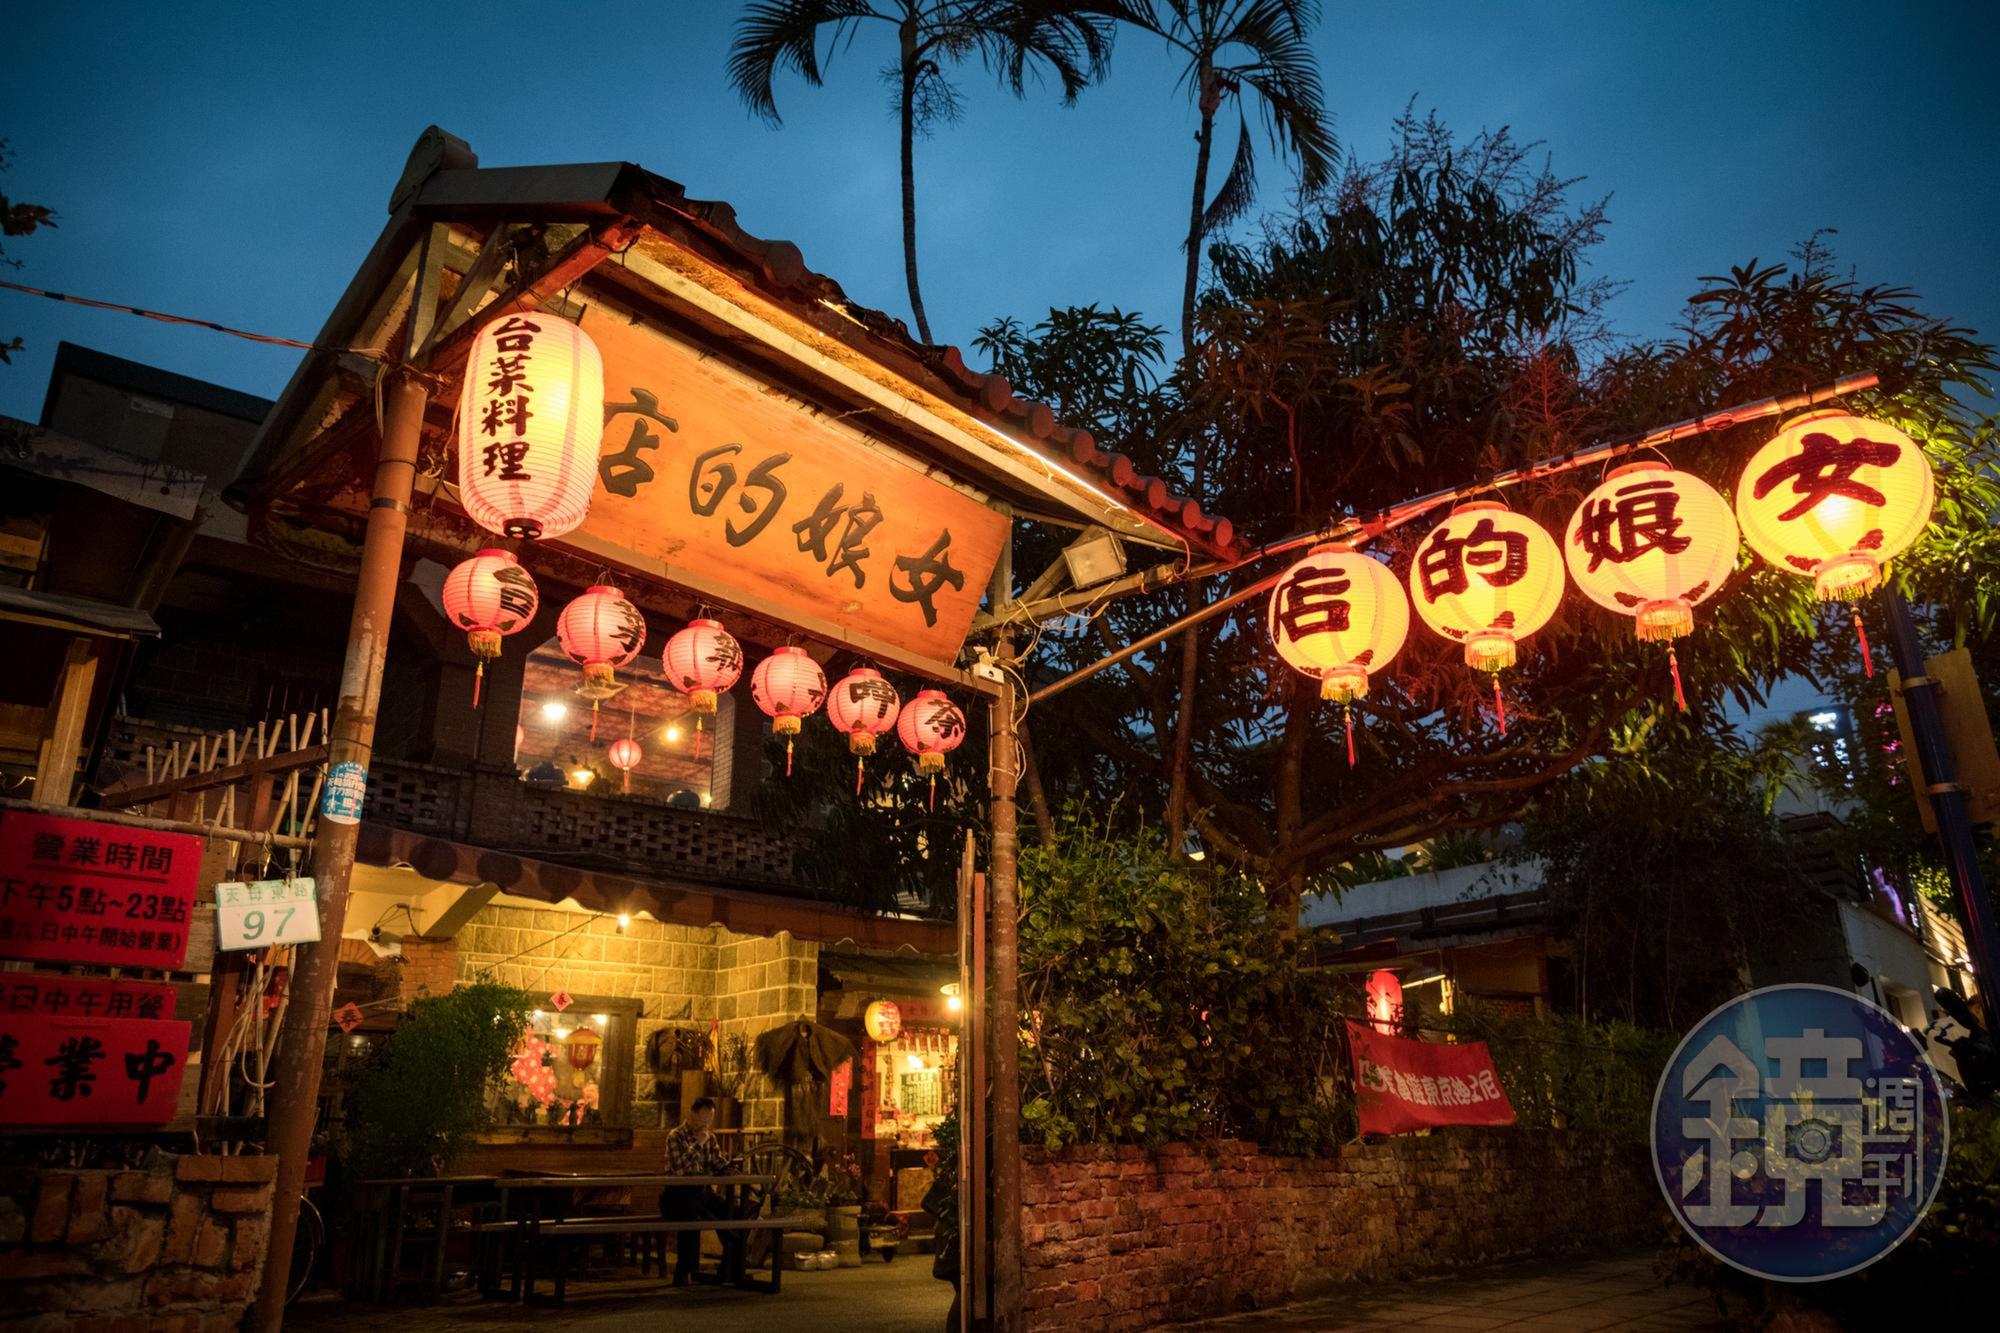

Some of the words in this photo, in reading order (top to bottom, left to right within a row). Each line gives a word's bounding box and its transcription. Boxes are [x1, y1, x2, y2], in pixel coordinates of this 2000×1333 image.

[481, 317, 542, 482] 台菜料理
[31, 831, 174, 875] 營業時間
[224, 882, 310, 904] 天母東路
[242, 906, 296, 940] 97
[0, 984, 165, 1020] 日中午用餐
